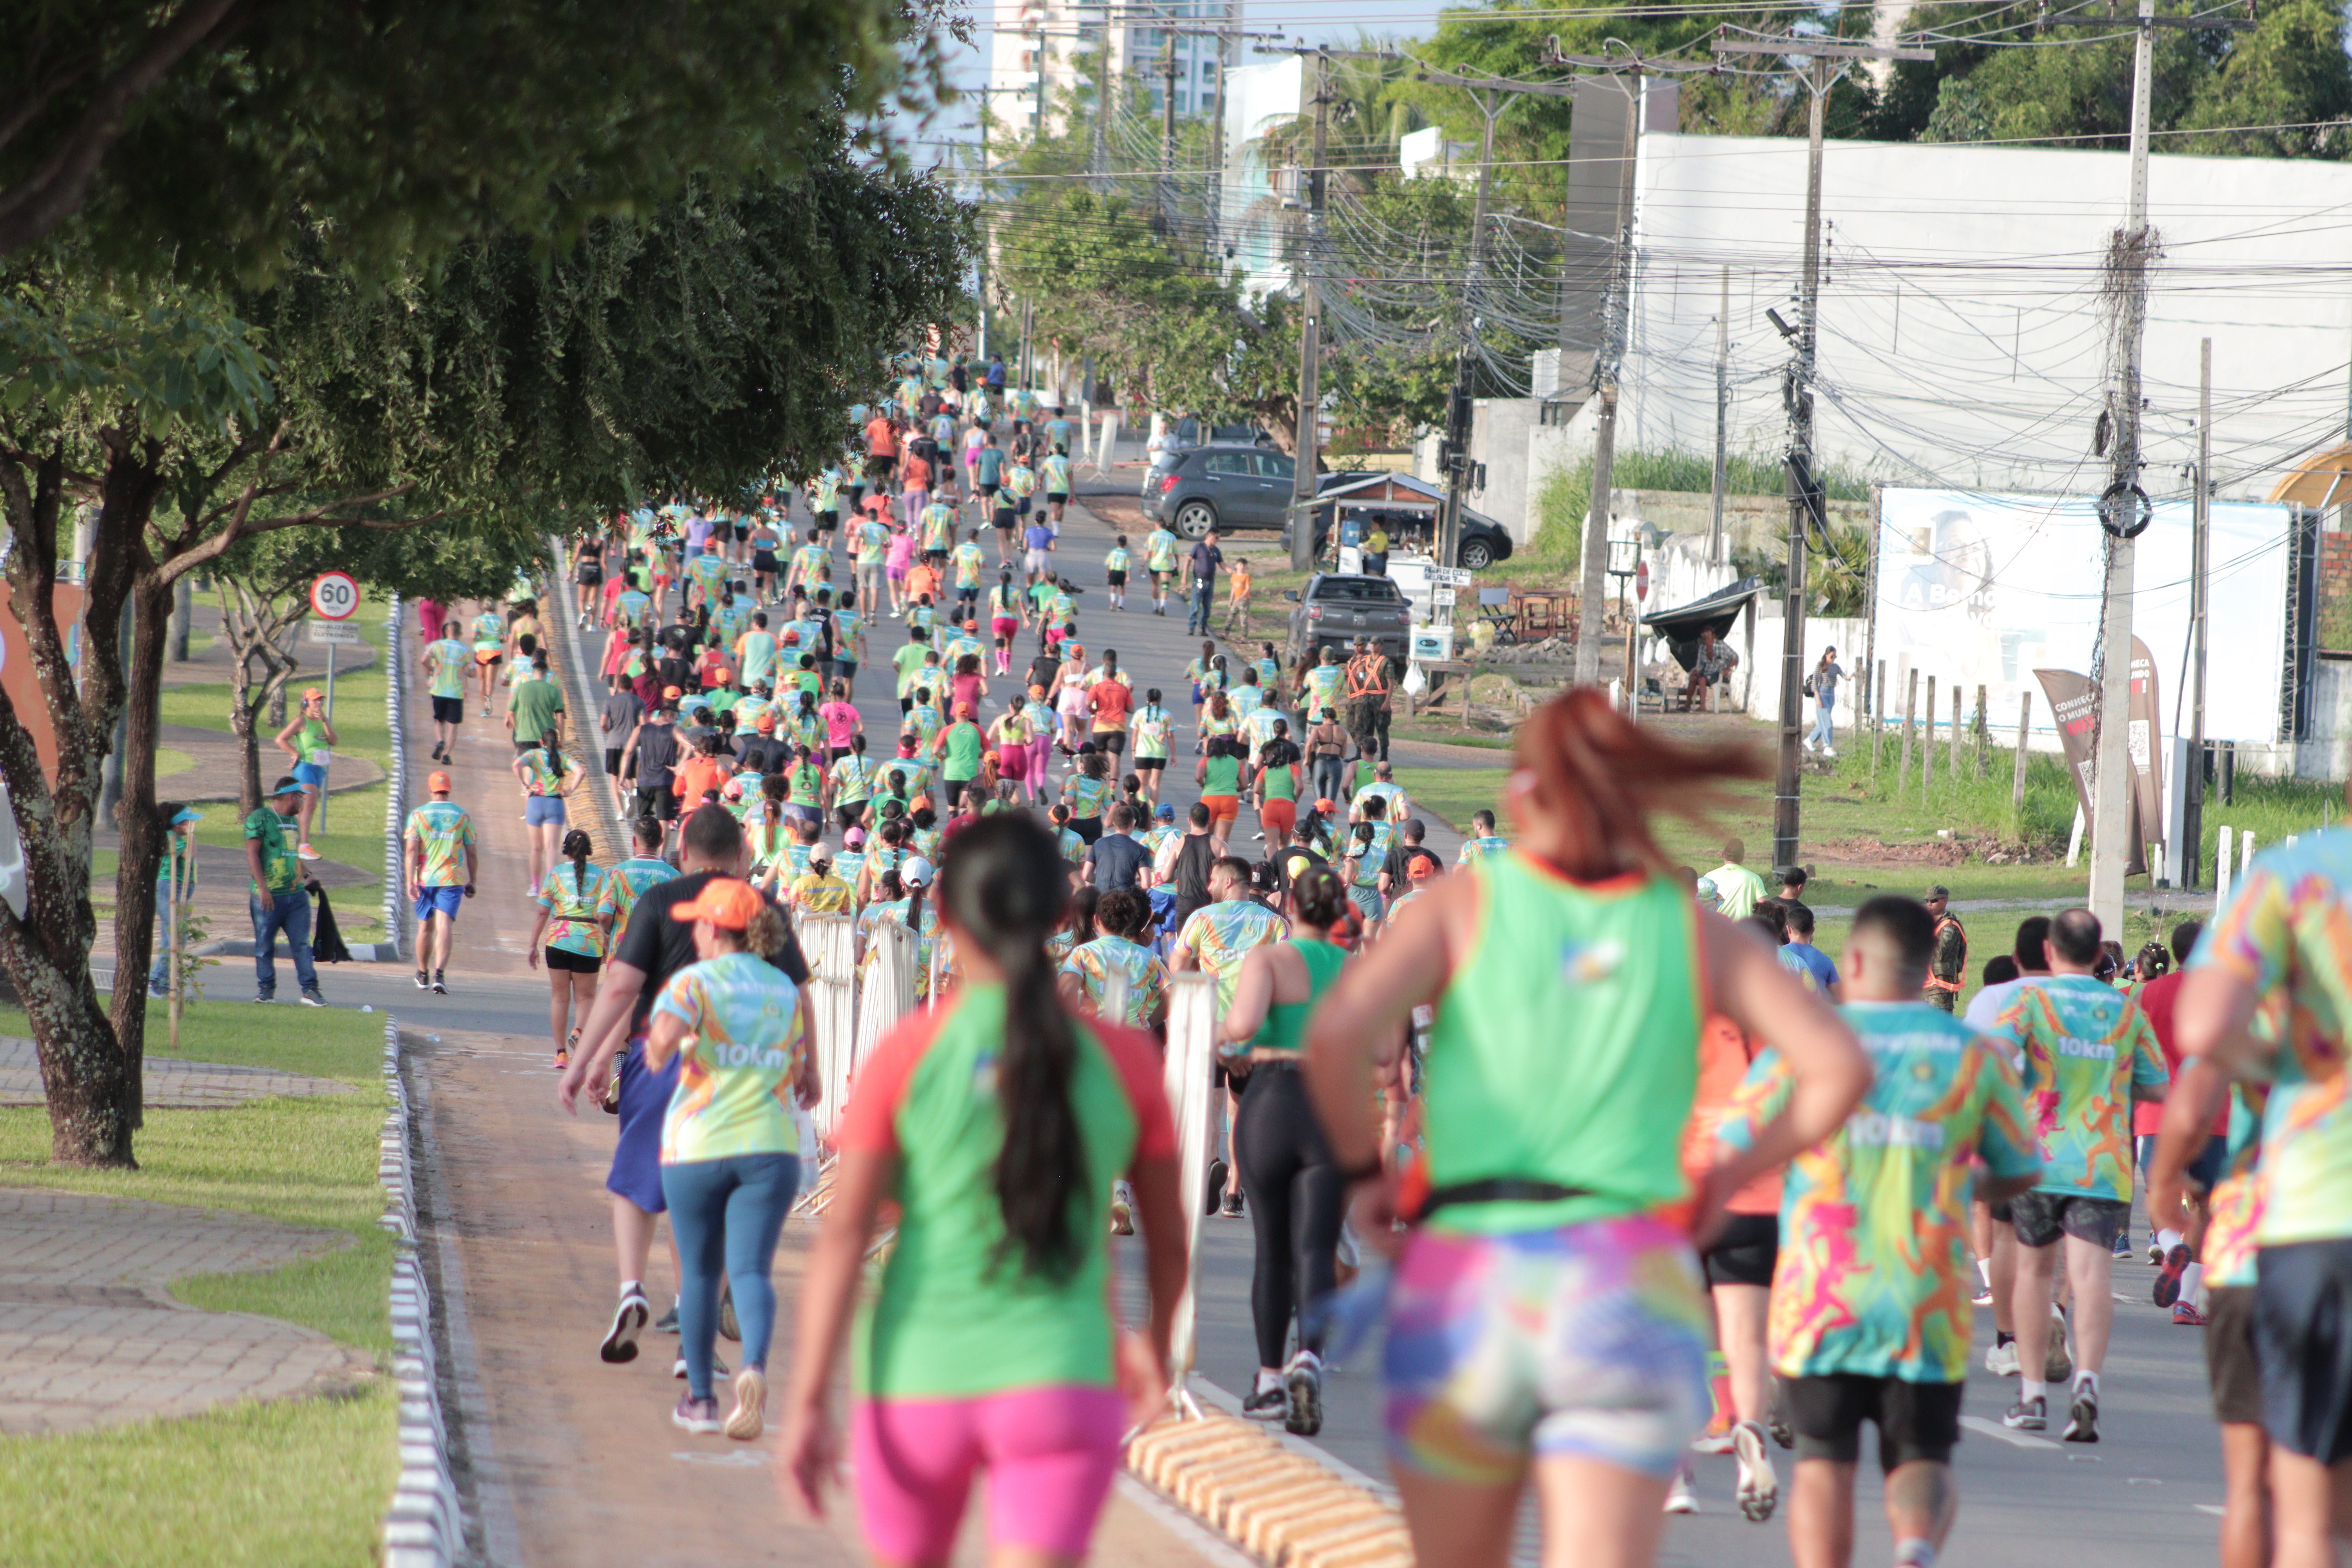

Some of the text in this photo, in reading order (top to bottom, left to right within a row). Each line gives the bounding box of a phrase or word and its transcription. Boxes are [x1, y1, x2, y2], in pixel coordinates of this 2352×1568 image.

[321, 583, 349, 604] 60
[2131, 659, 2150, 669] HECA
[2131, 670, 2150, 680] UNDO
[2058, 714, 2066, 722] O
[2058, 1035, 2116, 1060] 10km
